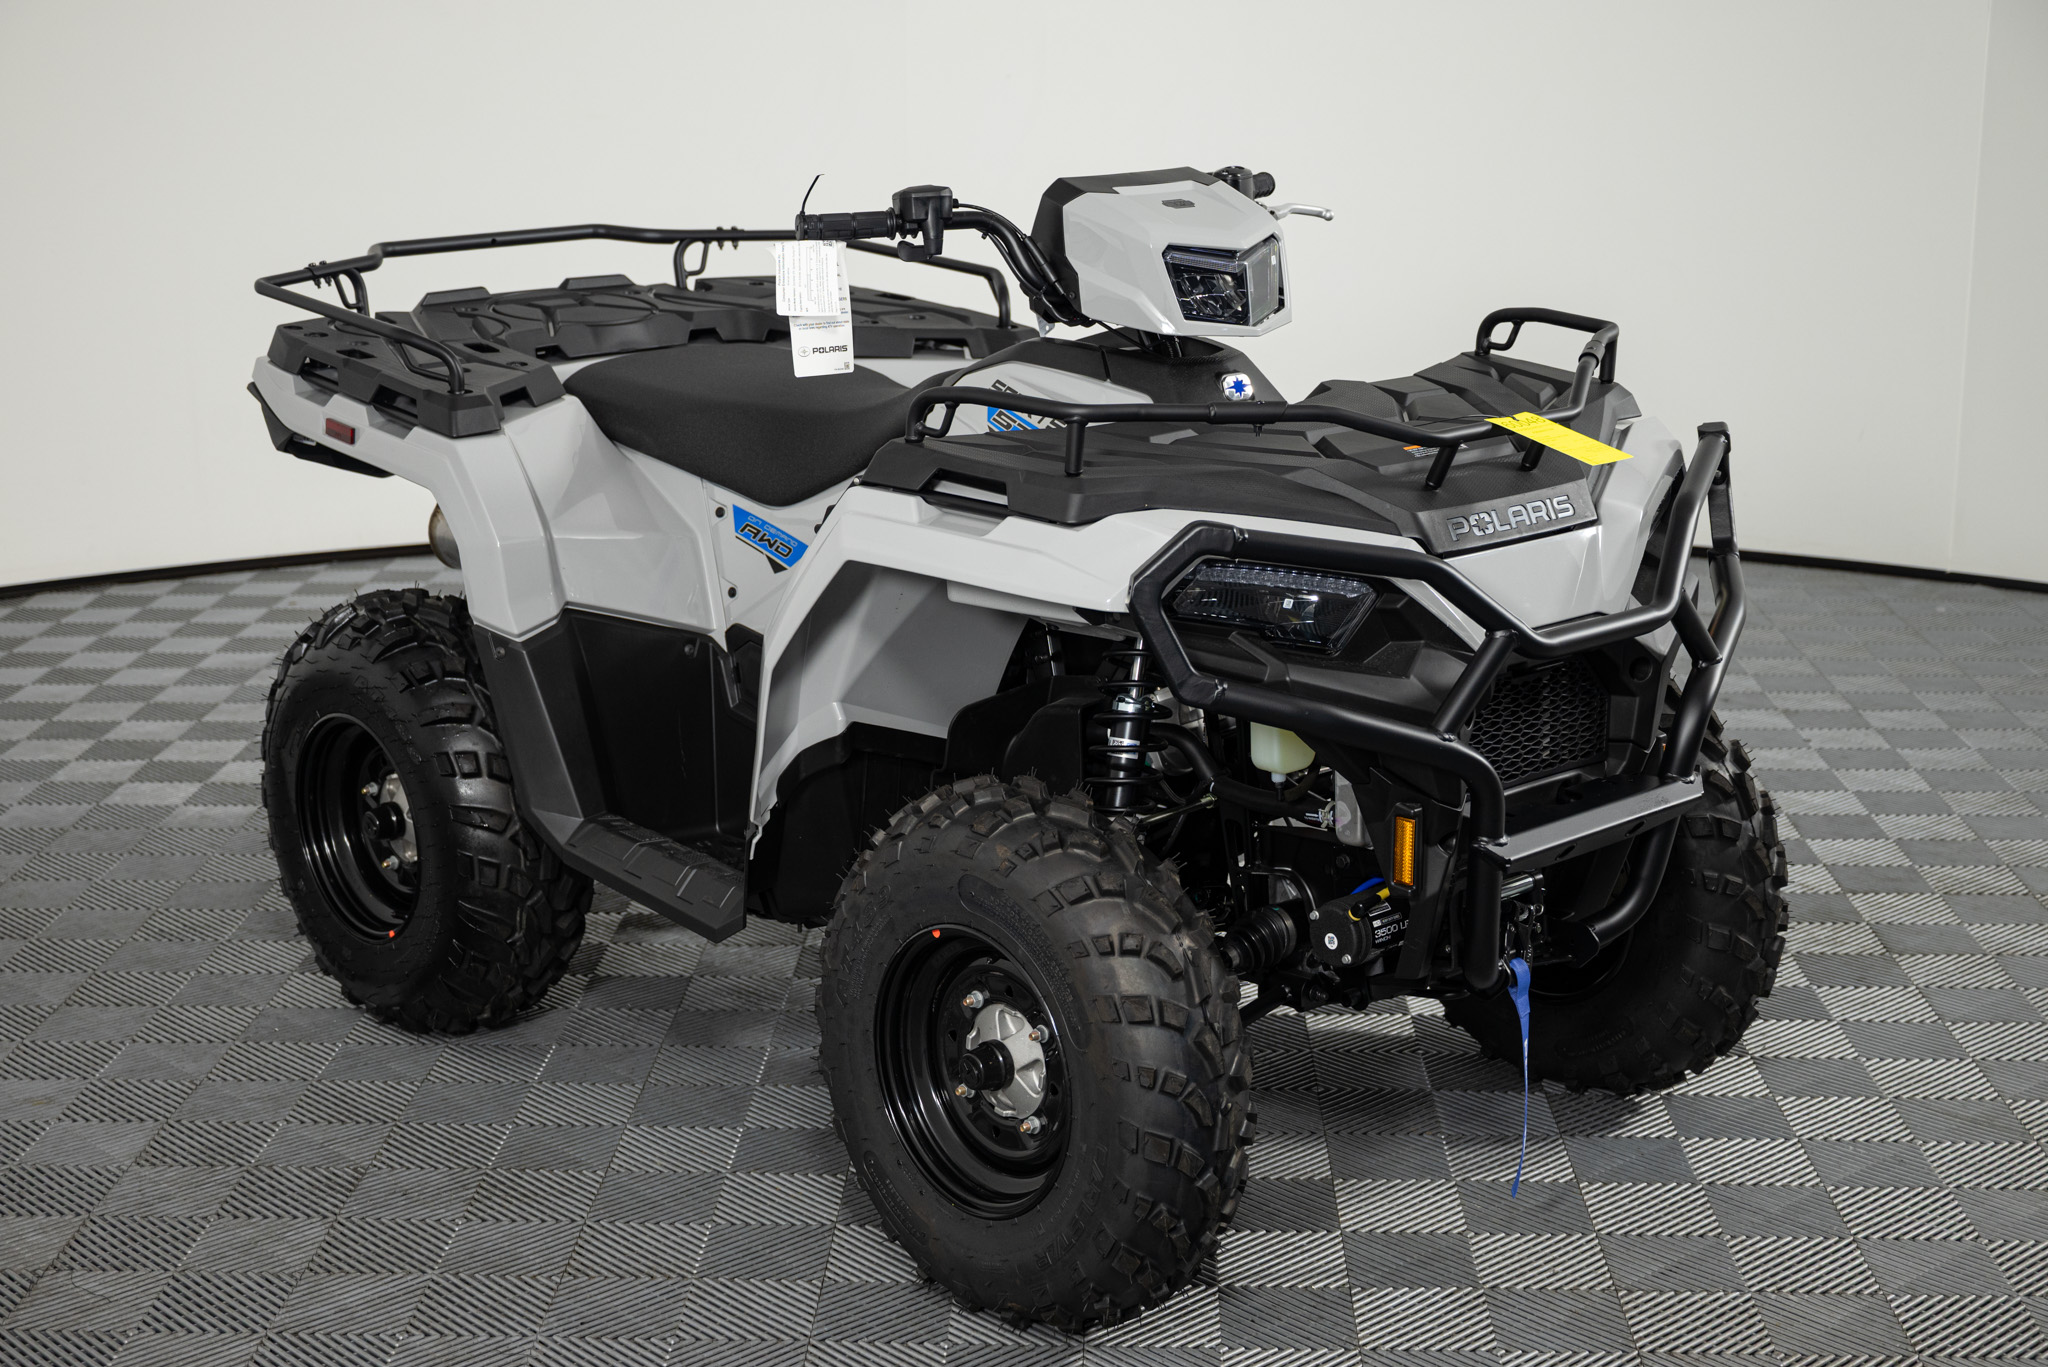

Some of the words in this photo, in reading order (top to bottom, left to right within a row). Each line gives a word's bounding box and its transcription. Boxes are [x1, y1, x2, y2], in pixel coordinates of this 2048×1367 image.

[812, 345, 848, 354] POLARIS
[1446, 495, 1576, 541] POLARIS
[738, 522, 793, 558] AWD
[764, 524, 798, 547] DEMAND
[1374, 924, 1398, 938] 3500
[1375, 935, 1391, 944] WINCH
